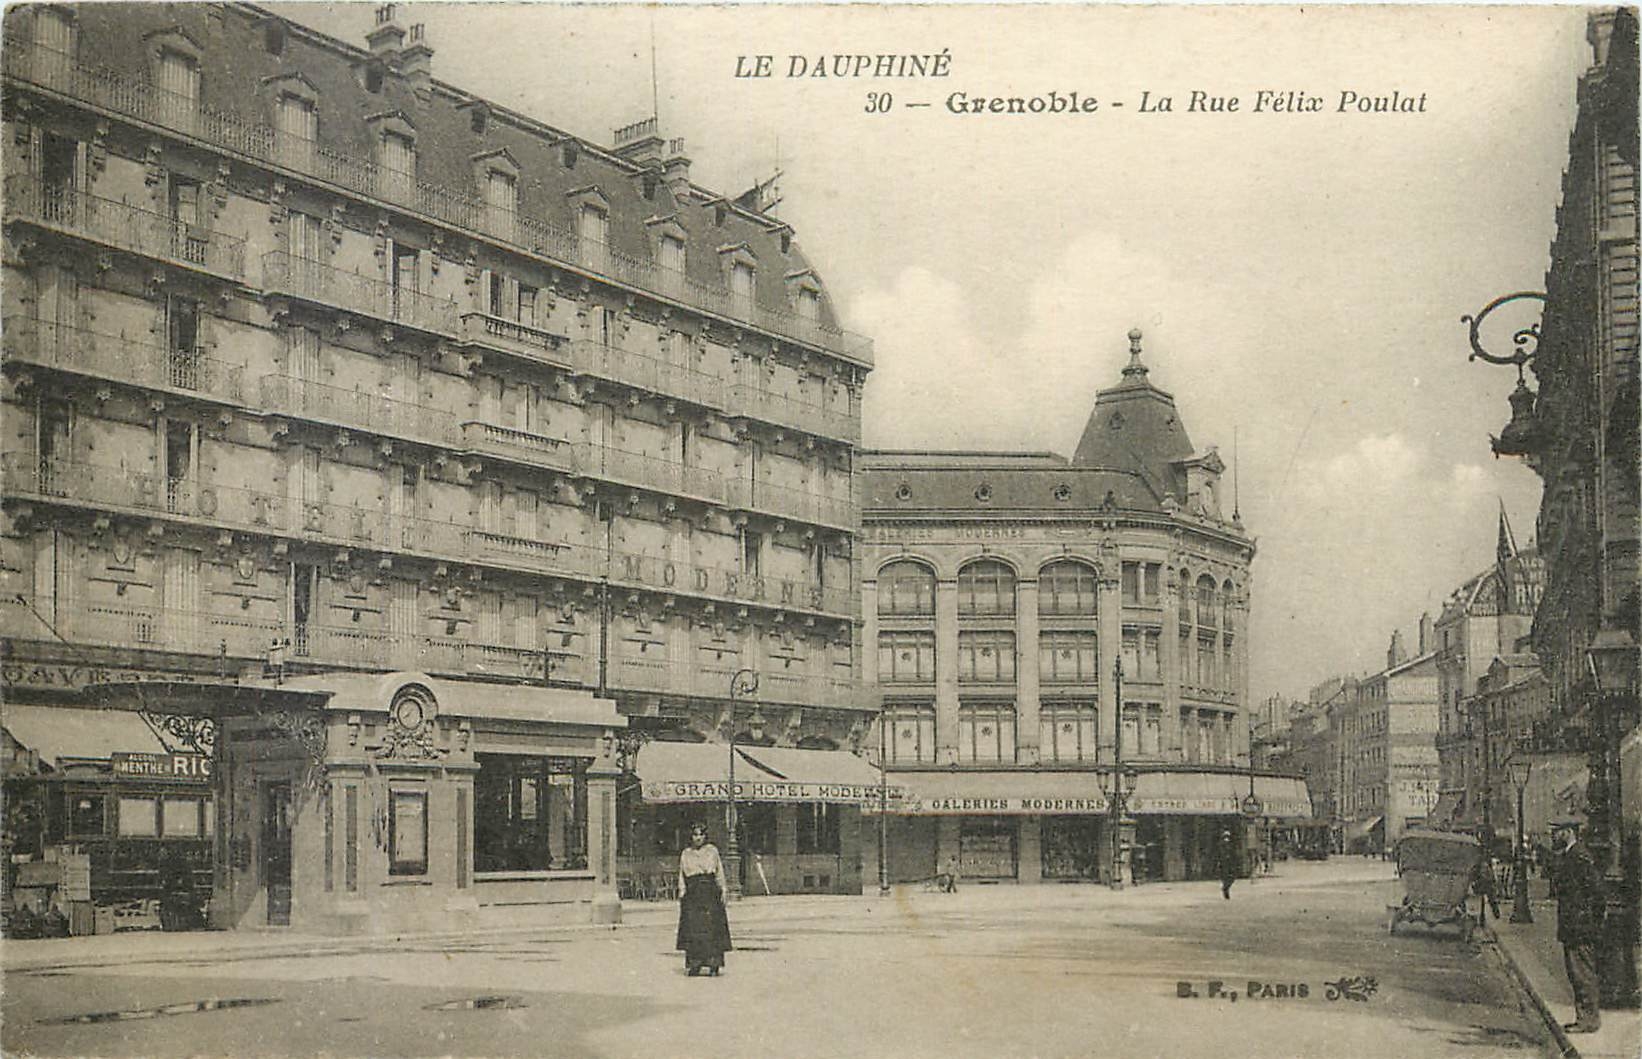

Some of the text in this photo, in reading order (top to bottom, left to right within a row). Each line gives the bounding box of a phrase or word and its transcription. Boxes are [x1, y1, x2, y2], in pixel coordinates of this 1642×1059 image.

[675, 783, 744, 797] GRAND
[752, 784, 810, 798] HOTEL
[932, 799, 1106, 810] GALERIES MODERNES
